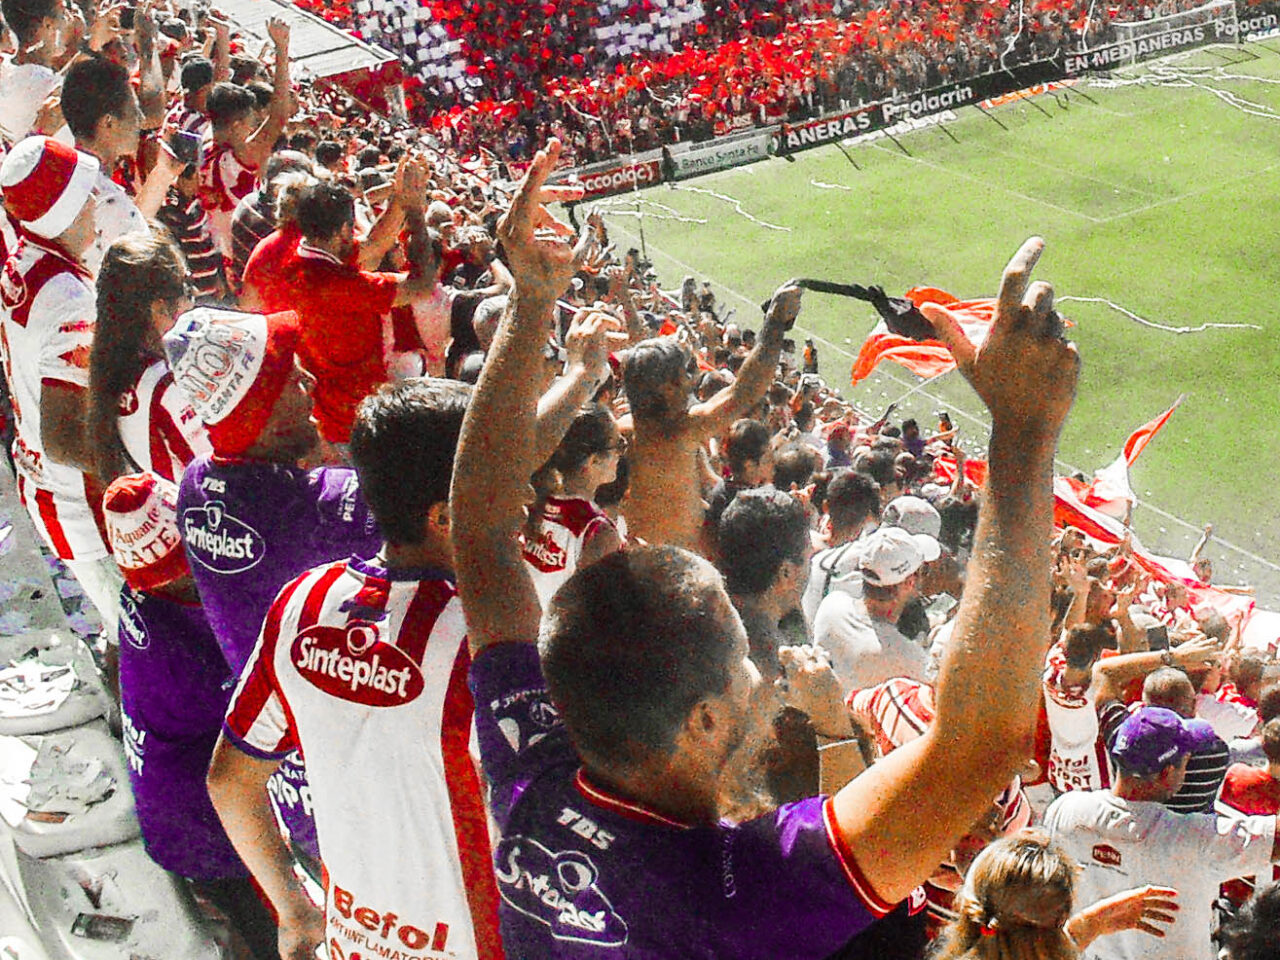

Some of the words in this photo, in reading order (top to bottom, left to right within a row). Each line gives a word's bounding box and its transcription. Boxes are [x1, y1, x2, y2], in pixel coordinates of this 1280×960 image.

[1064, 56, 1089, 74] EN
[1092, 27, 1205, 67] MEDIANERAS
[1215, 14, 1278, 38] Poacrin
[184, 516, 255, 561] Sinteplast
[296, 636, 412, 699] Sinteplast
[334, 885, 449, 952] Befol
